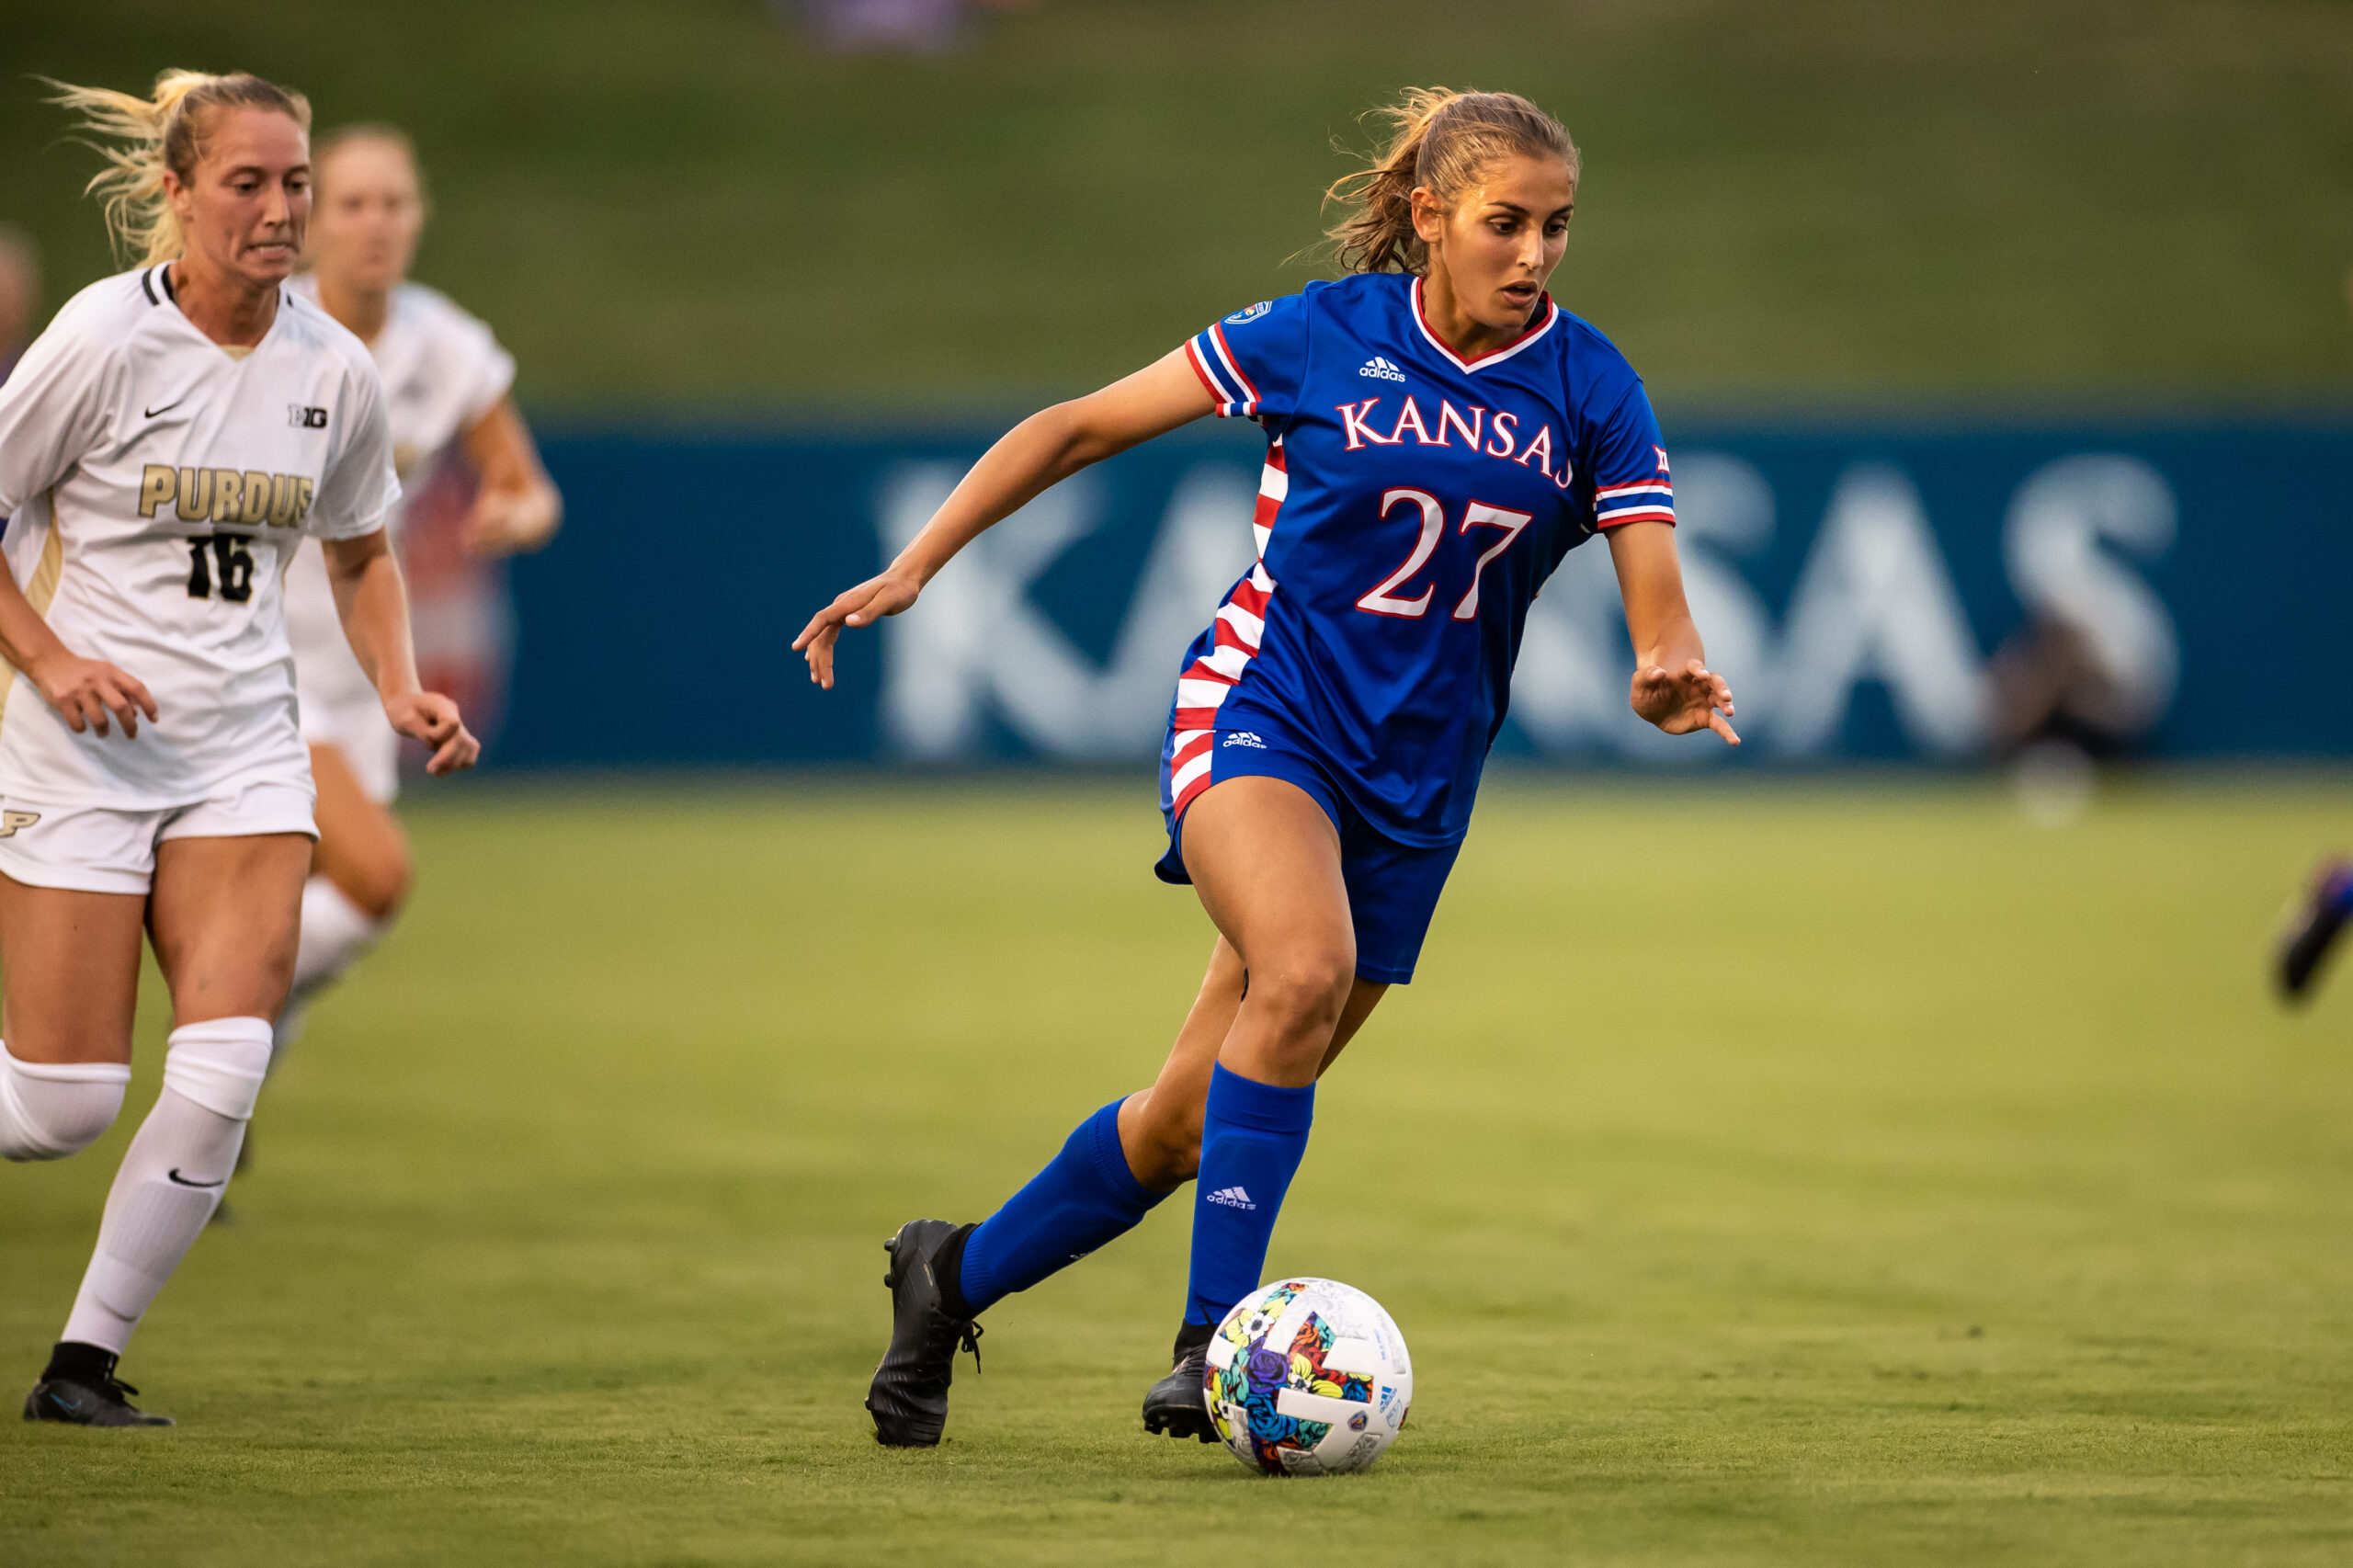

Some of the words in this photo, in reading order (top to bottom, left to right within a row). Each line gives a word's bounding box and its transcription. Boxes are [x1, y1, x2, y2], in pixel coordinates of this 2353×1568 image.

[1358, 366, 1406, 383] adidas
[186, 530, 255, 605] 16
[1355, 485, 1534, 622] 27
[878, 453, 2180, 761] KASAS
[1206, 1194, 1257, 1210] adidas
